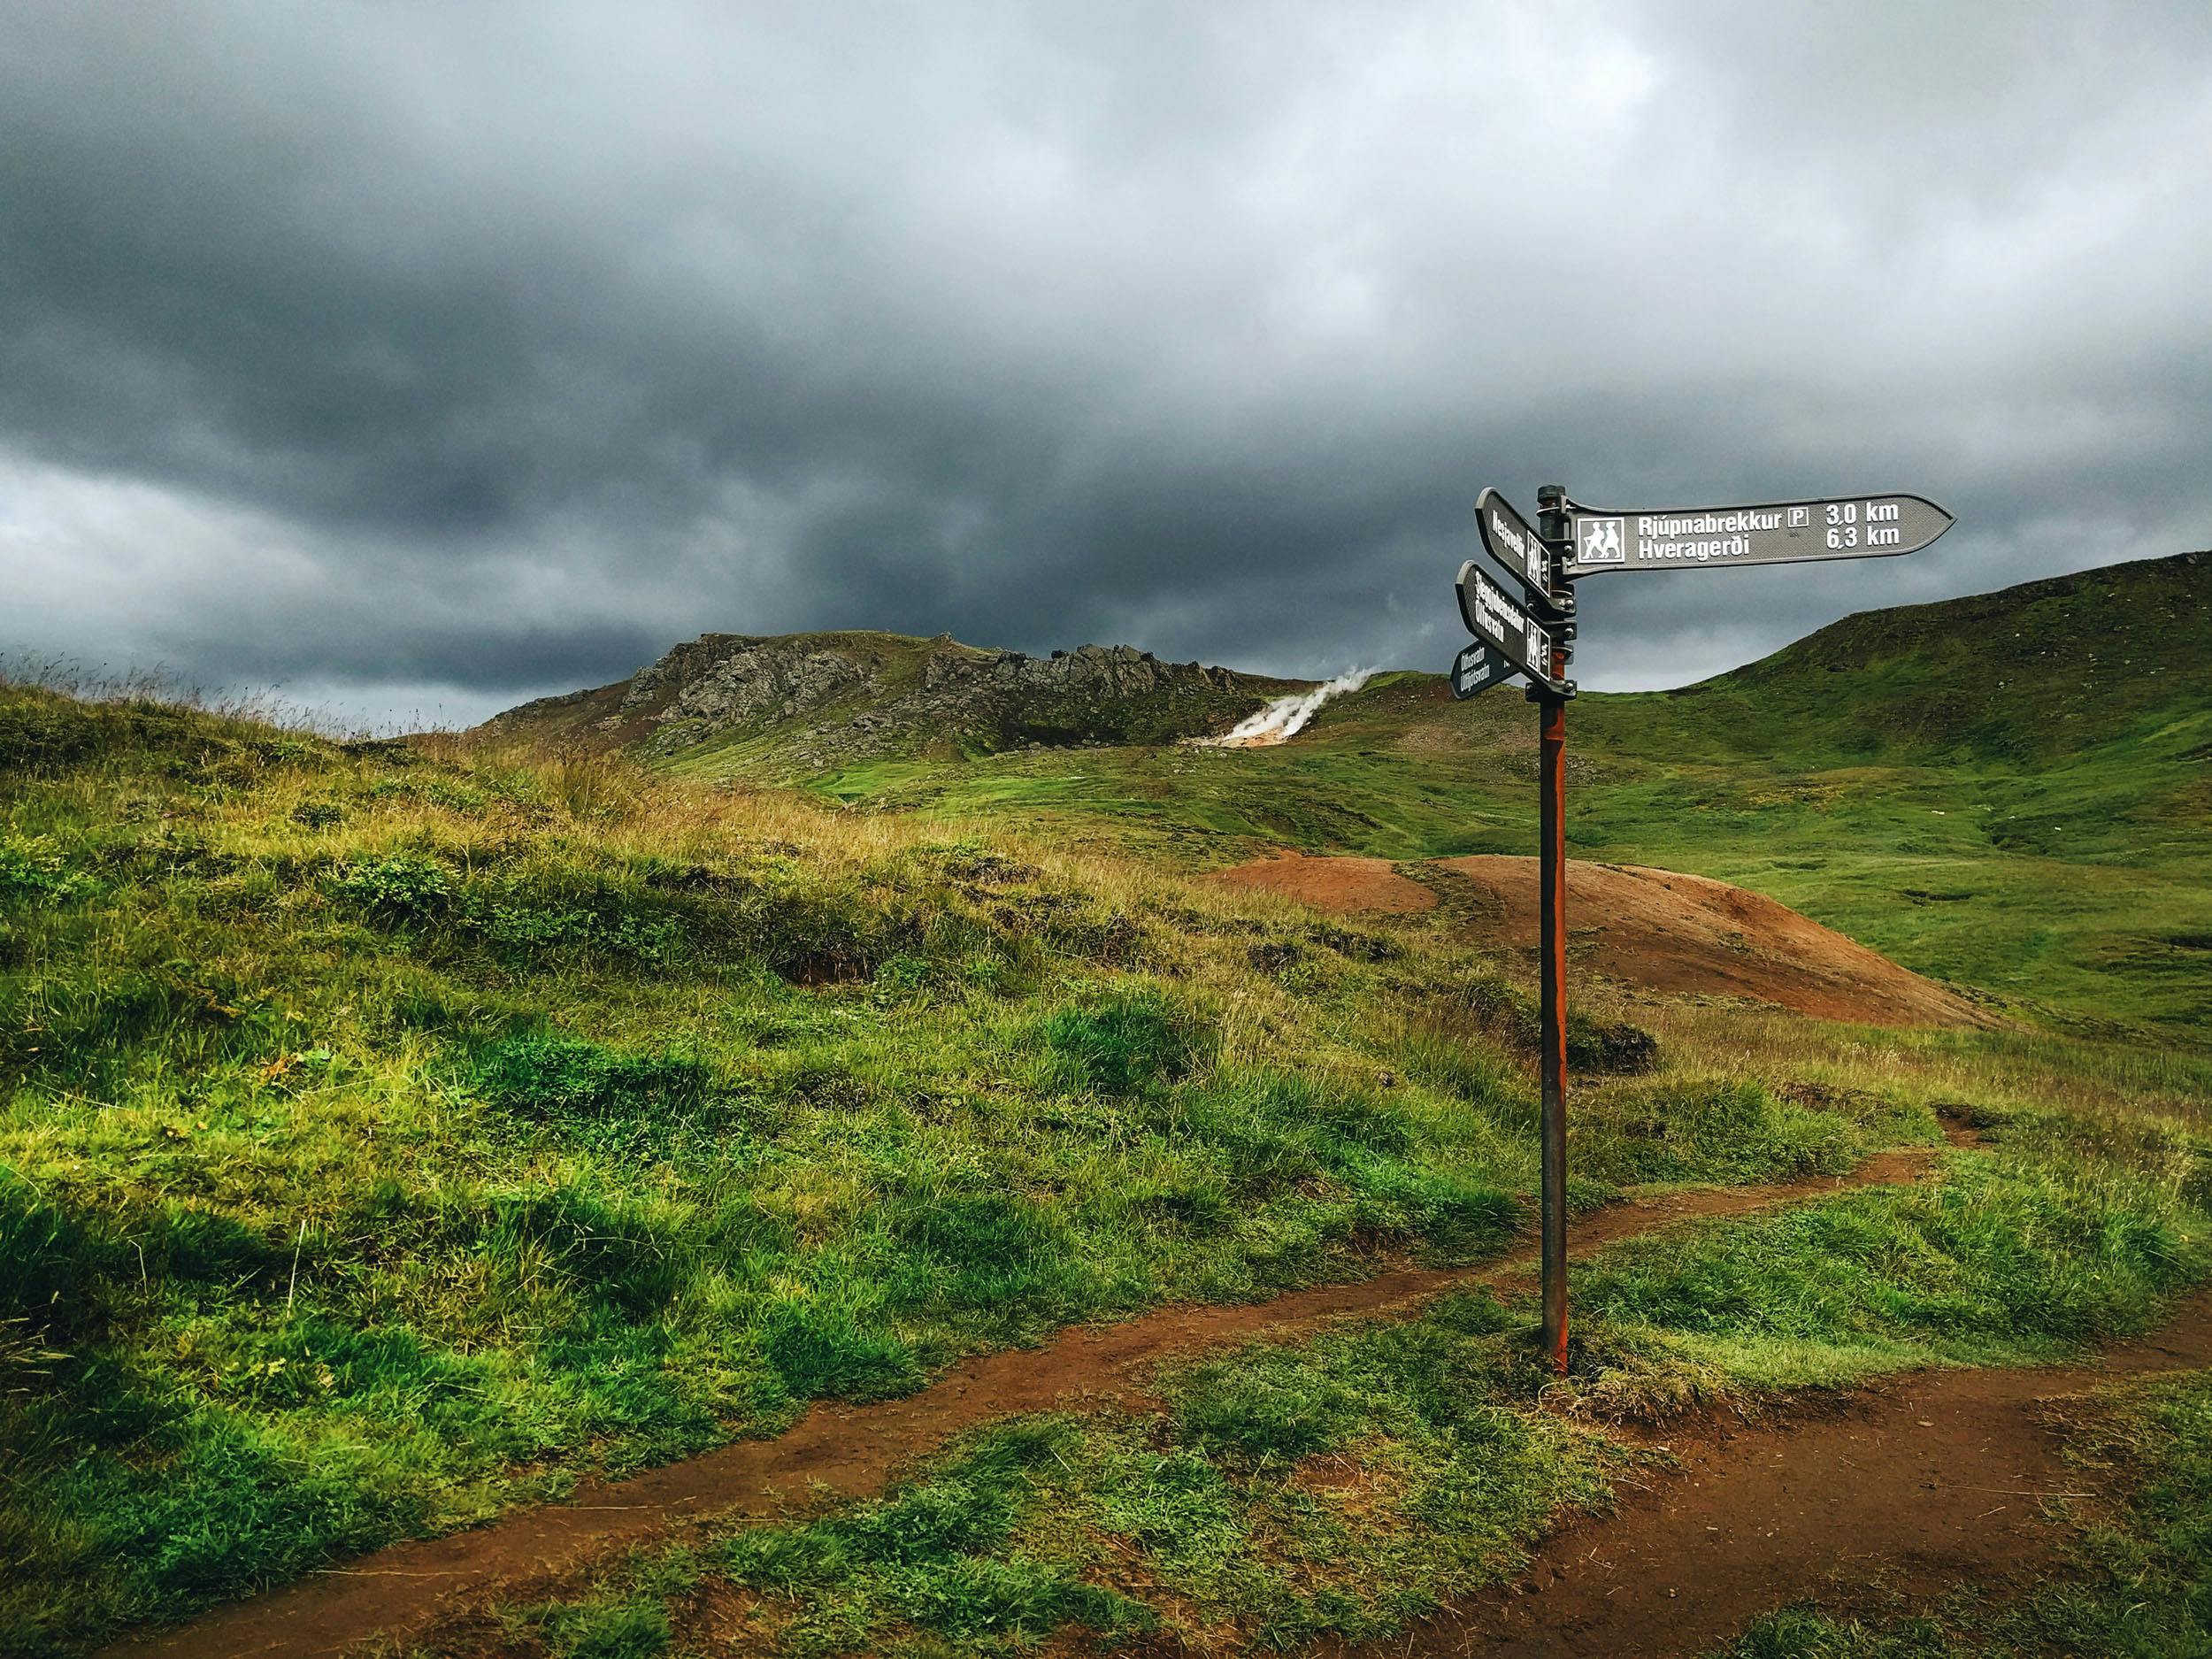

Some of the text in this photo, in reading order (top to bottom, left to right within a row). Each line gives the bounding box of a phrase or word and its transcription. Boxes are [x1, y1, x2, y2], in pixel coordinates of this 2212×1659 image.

[1638, 511, 1782, 539] Rjúpnabrekkur
[1825, 503, 1856, 526] 3,0
[1866, 502, 1899, 522] km
[1638, 526, 1900, 561] Hveragerði 6,3 km
